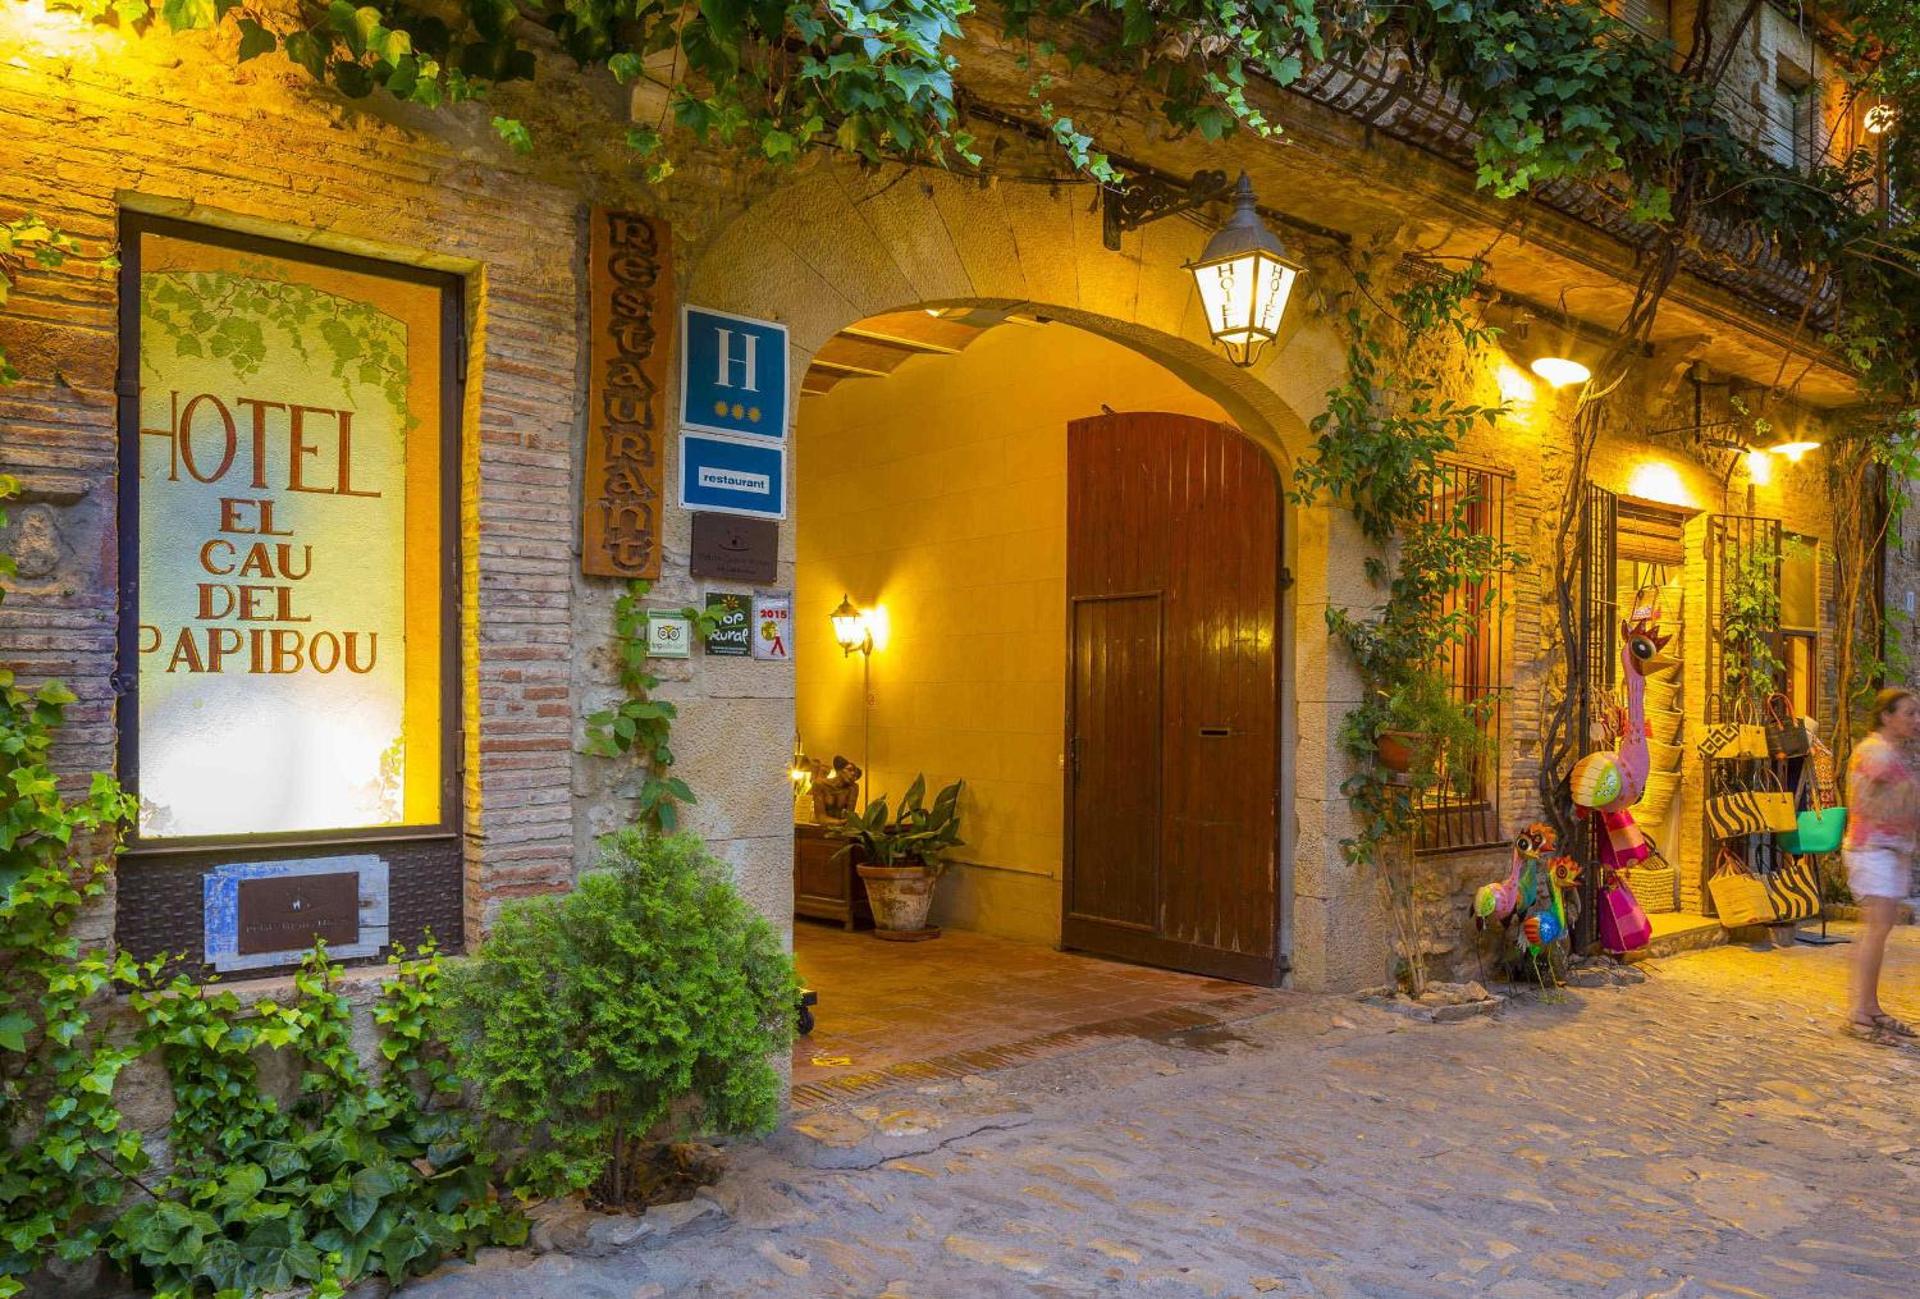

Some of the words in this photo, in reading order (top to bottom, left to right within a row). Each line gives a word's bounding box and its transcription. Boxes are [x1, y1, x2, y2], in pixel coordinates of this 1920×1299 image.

[713, 327, 760, 393] H
[139, 385, 382, 498] HOTEL
[703, 471, 765, 490] restaurant
[218, 497, 294, 537] EL
[199, 538, 313, 581] CAU
[194, 582, 312, 623] DEL
[759, 608, 788, 619] 2015
[139, 624, 378, 675] PAPIBOU
[708, 627, 749, 646] Rural
